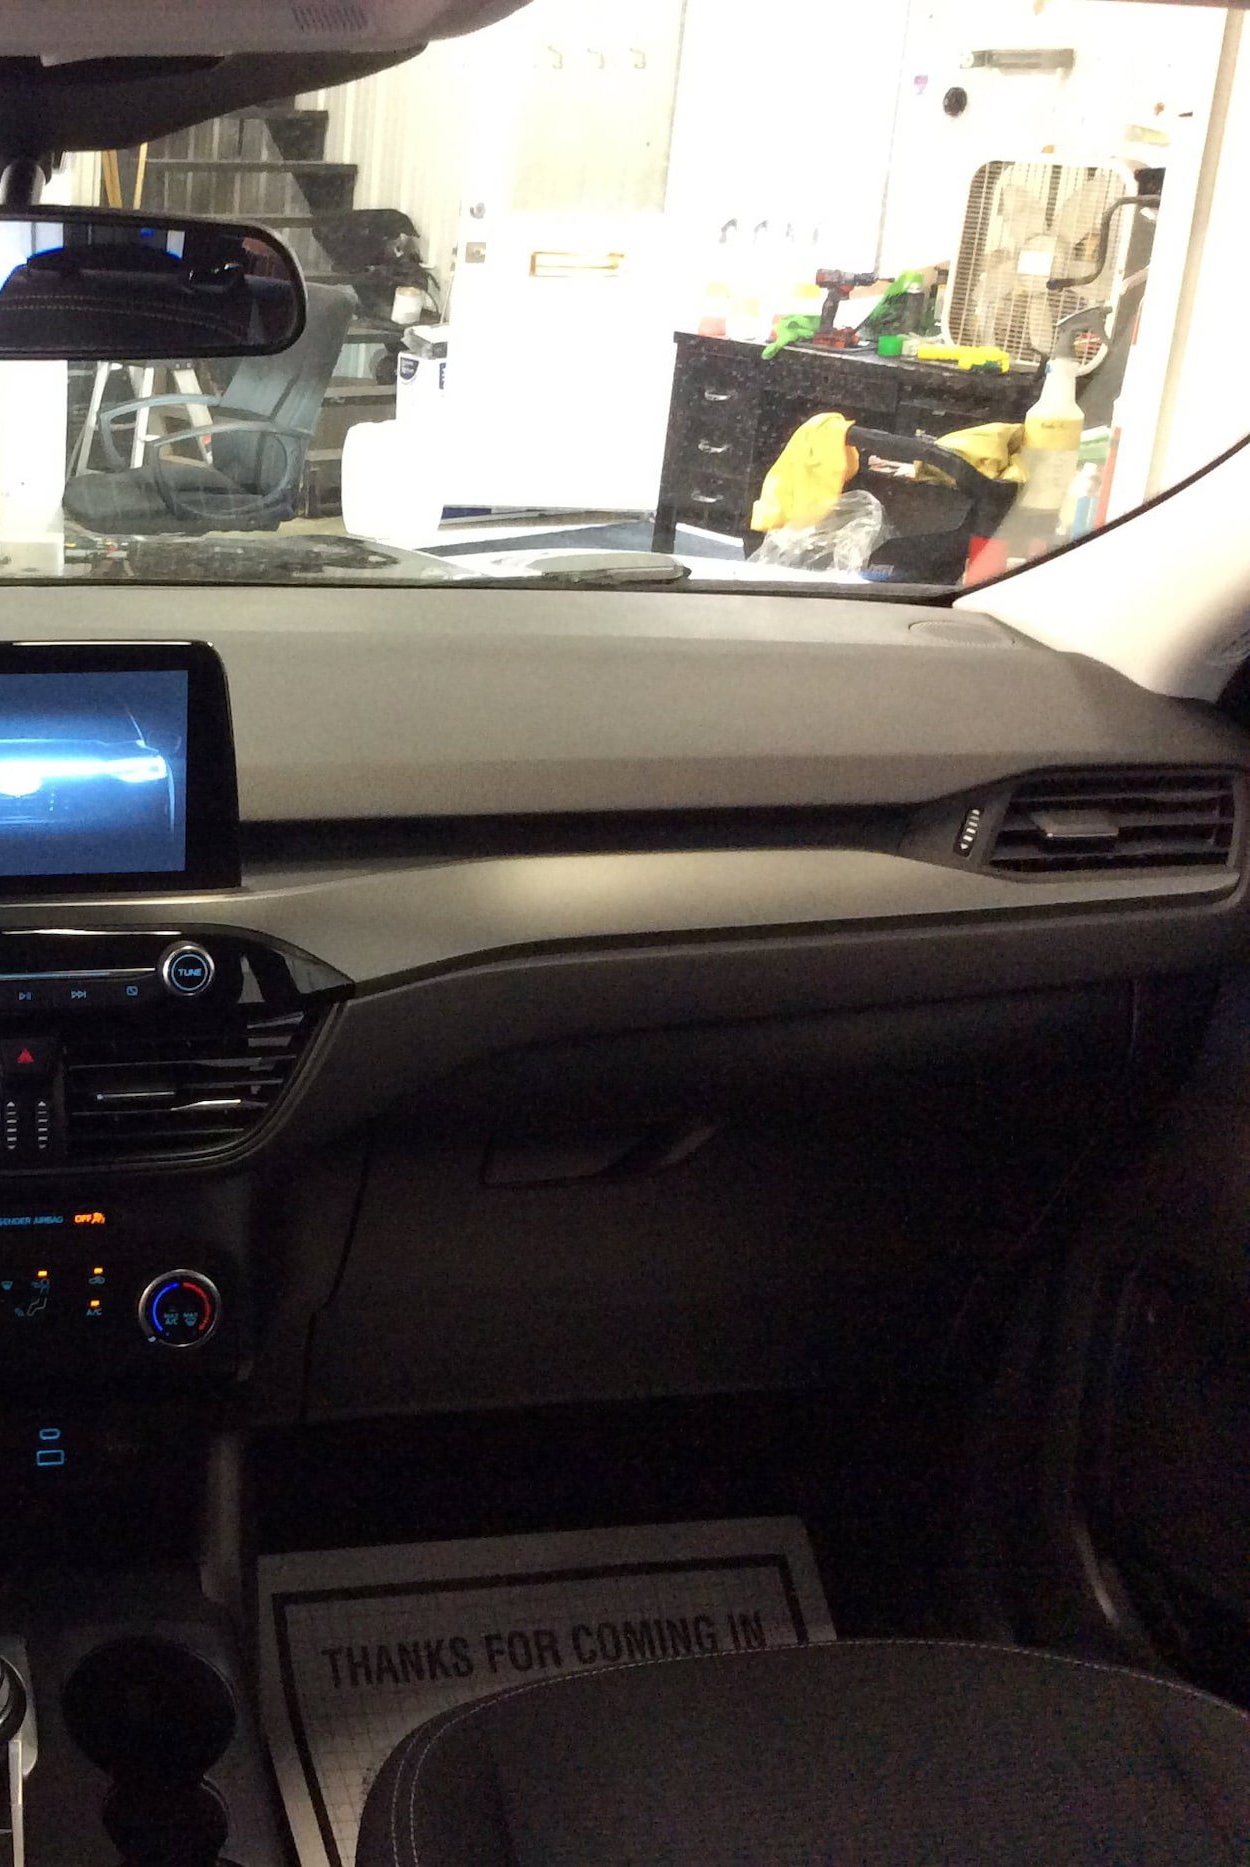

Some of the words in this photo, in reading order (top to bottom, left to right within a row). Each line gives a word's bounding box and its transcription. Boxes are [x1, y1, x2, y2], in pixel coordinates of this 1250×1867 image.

[177, 968, 202, 977] TUNE
[33, 1216, 64, 1224] AIRBAG
[74, 1215, 91, 1223] OFF
[86, 1308, 103, 1316] A/C
[321, 1637, 475, 1688] THANKS
[484, 1630, 562, 1673] FOR
[571, 1613, 719, 1665] COMING
[730, 1611, 767, 1649] IN
